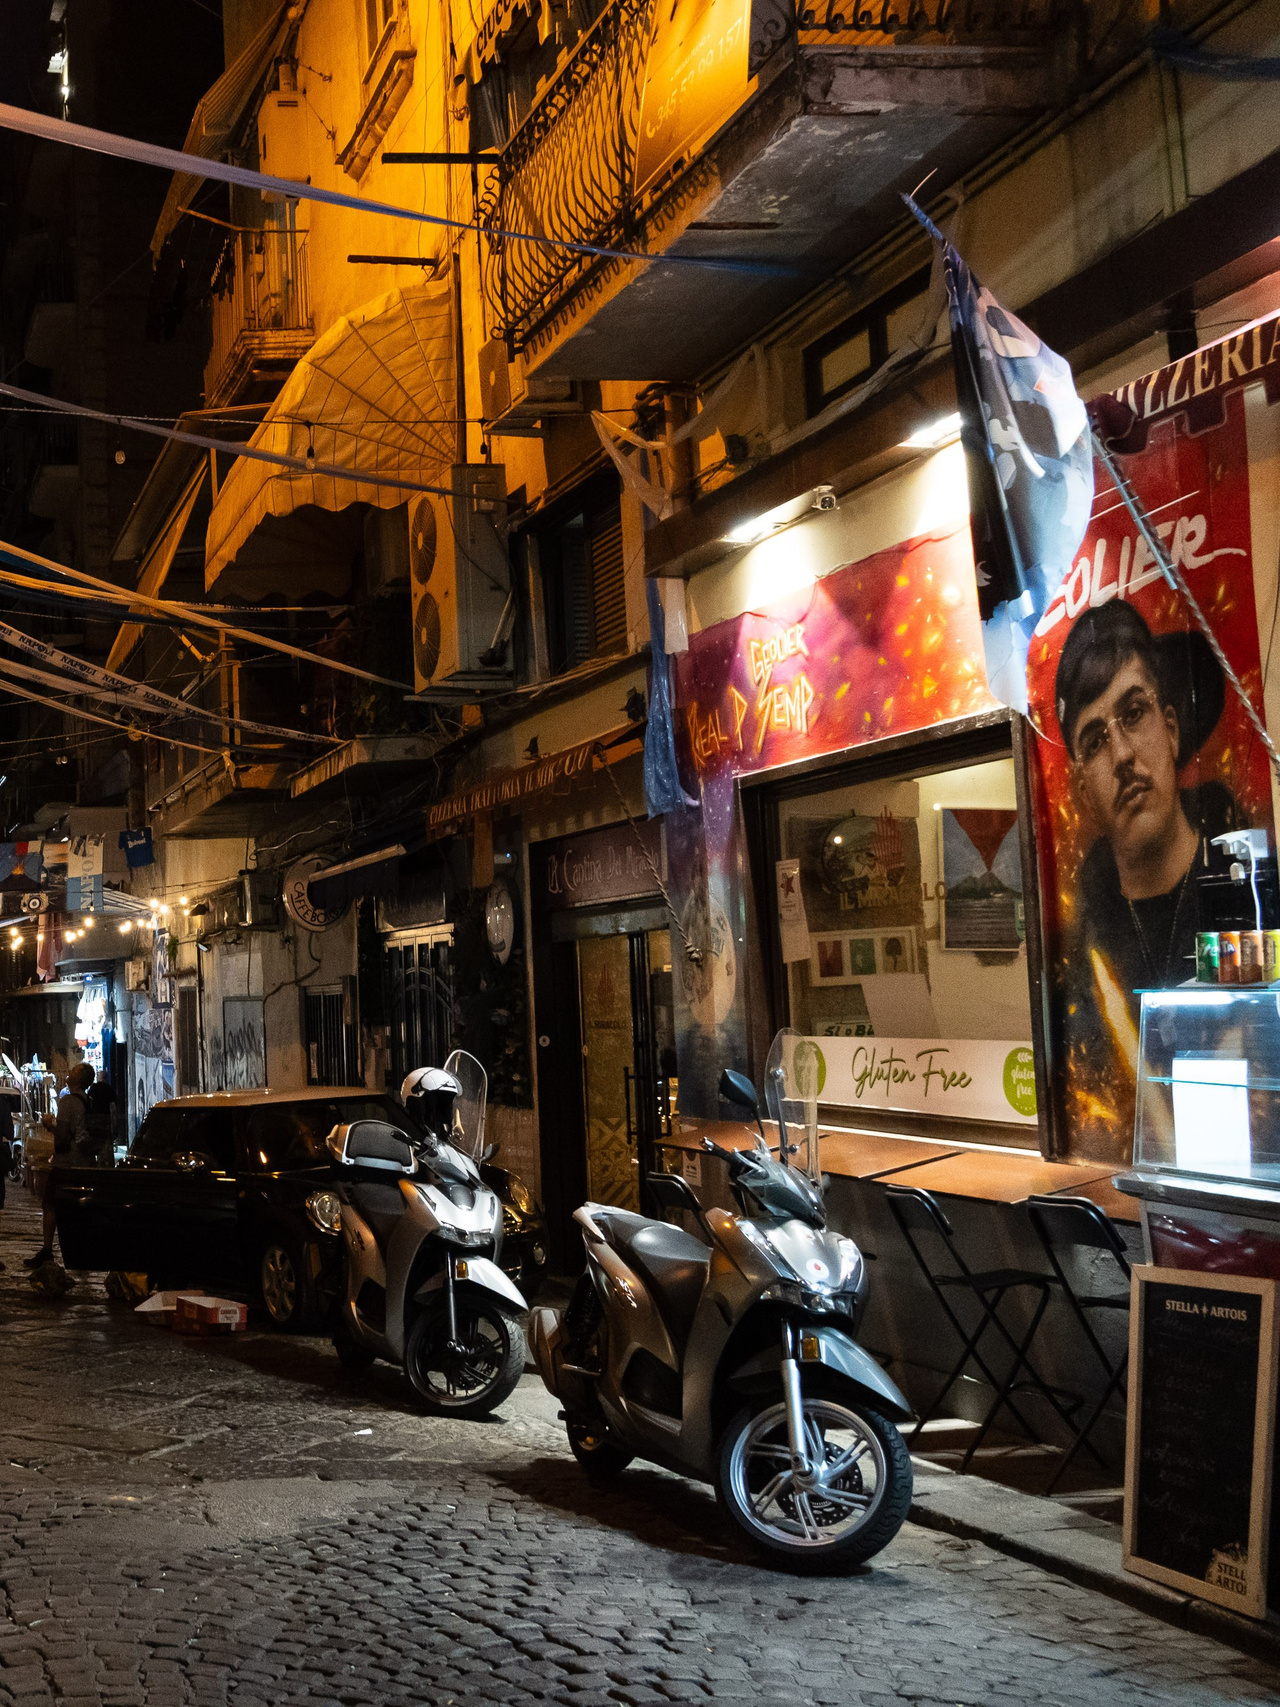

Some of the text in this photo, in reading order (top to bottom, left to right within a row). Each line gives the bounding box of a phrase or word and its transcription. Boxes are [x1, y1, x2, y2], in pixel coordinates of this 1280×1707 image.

[750, 623, 809, 686] GEOLIER
[688, 702, 728, 770] REAL
[729, 684, 748, 751] P
[852, 1045, 973, 1099] Gluten Free
[1165, 1299, 1248, 1322] STELLA ARTOIS
